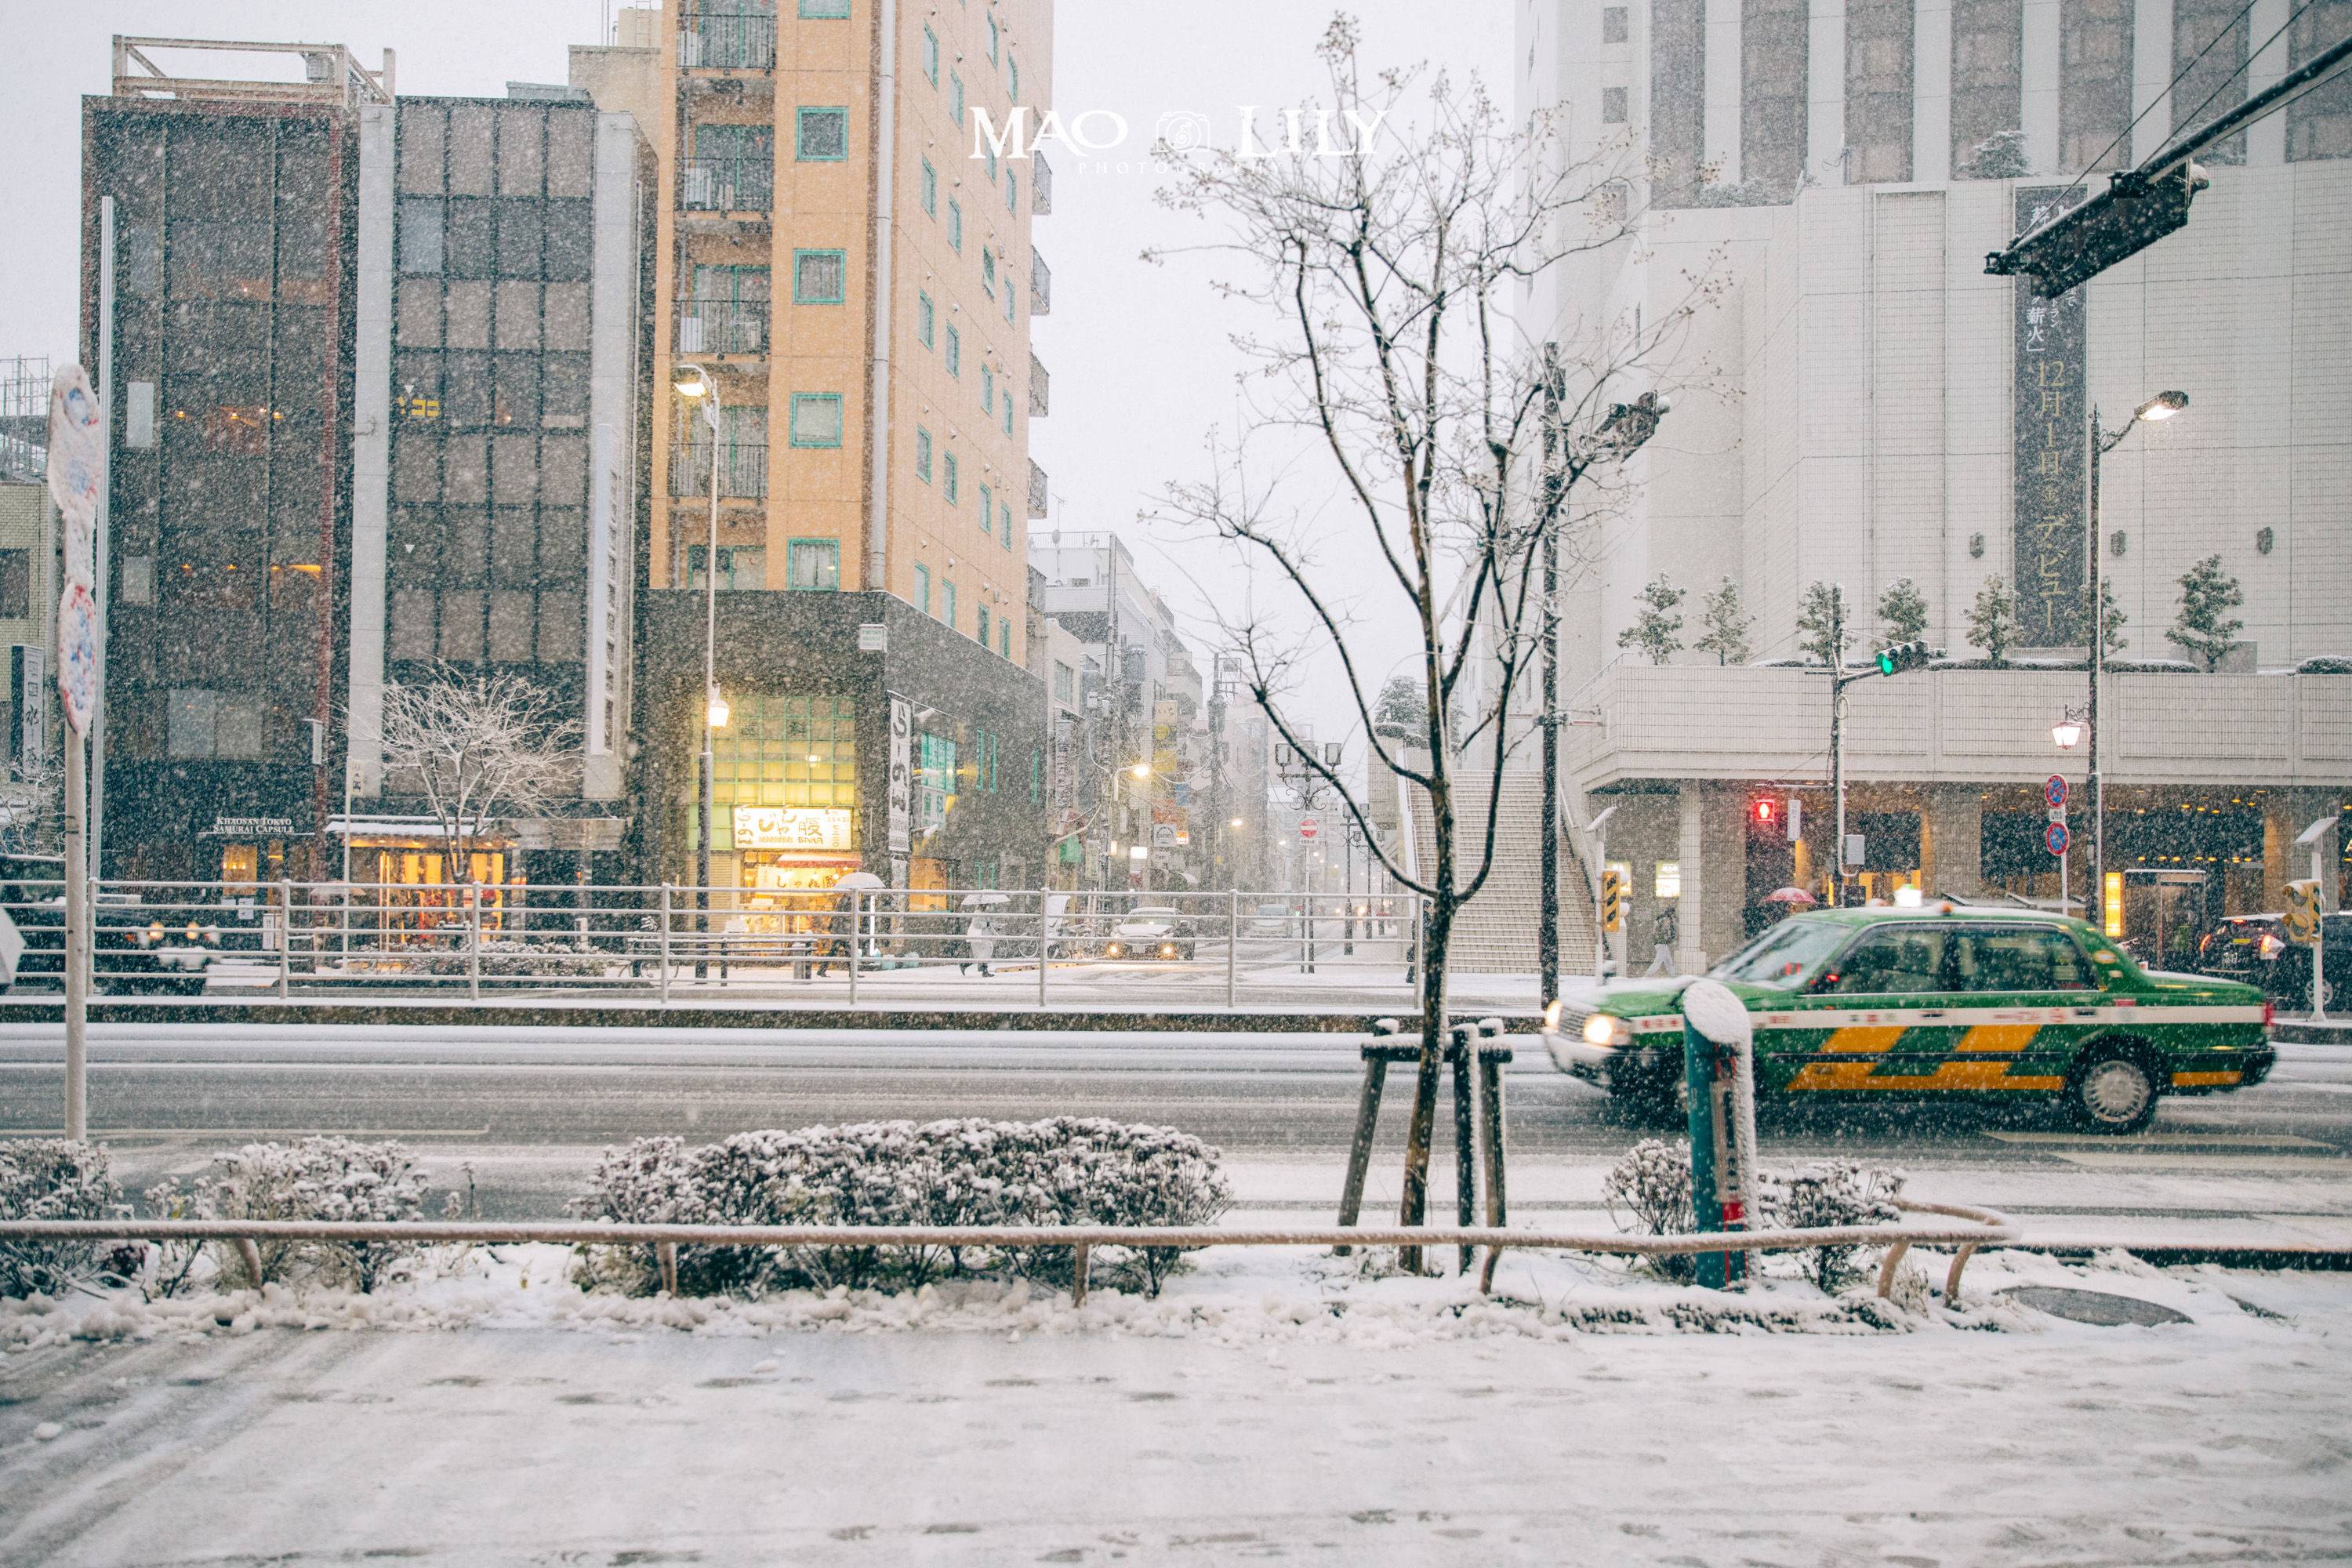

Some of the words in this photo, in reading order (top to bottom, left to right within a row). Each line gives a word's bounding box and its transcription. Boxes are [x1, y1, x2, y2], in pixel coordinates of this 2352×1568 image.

[261, 817, 292, 826] TOKYO
[213, 824, 253, 833] SAMURAI
[256, 825, 295, 833] CAPSULE
